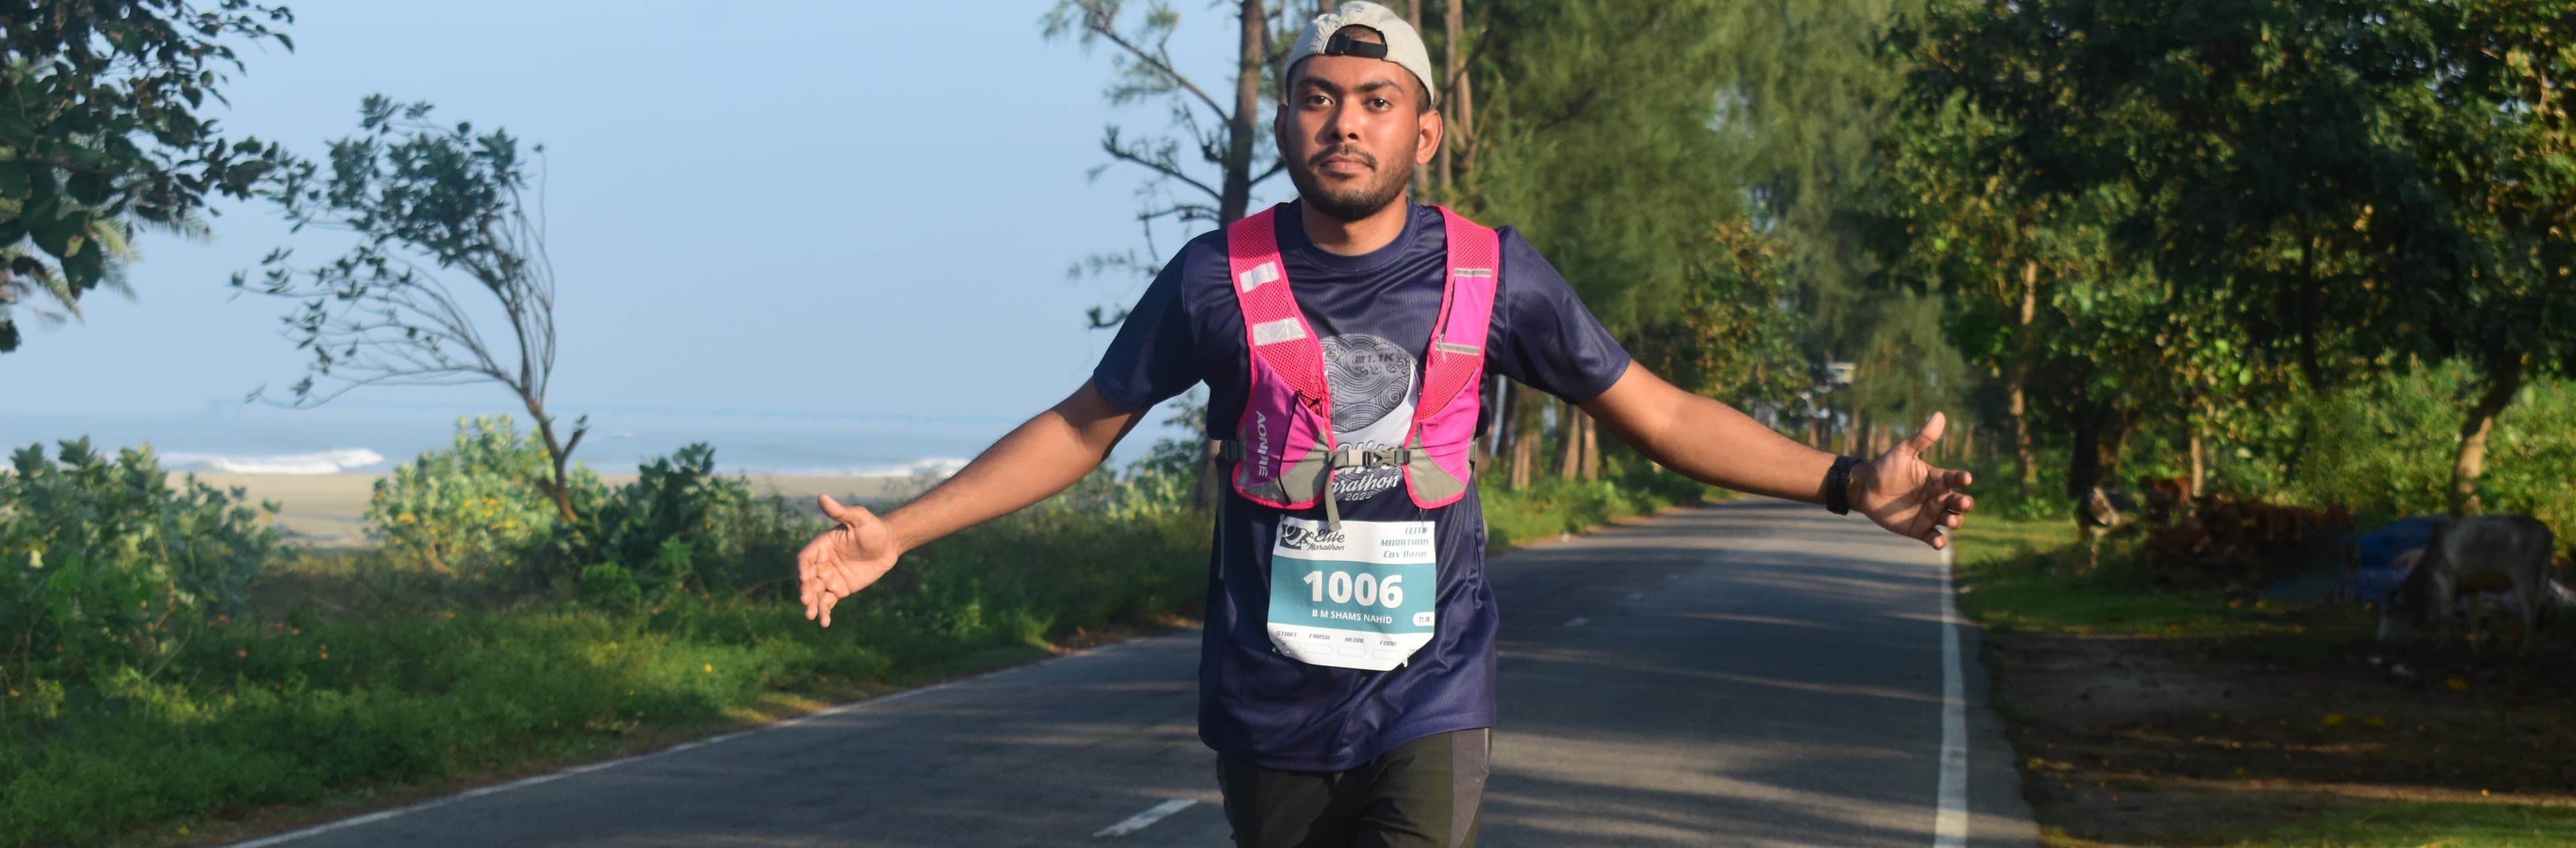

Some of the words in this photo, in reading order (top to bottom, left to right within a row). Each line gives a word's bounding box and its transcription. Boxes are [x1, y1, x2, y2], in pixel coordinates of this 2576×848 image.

[1256, 411, 1269, 477] AONIJIE
[1332, 473, 1399, 494] arathon
[1313, 529, 1345, 543] Elite
[1380, 539, 1429, 547] MARATHON
[1307, 543, 1345, 551] Marathon
[1303, 570, 1403, 608] 1006
[1312, 609, 1318, 617] B
[1330, 611, 1361, 621] SHAMS
[1363, 615, 1393, 624] NAHID
